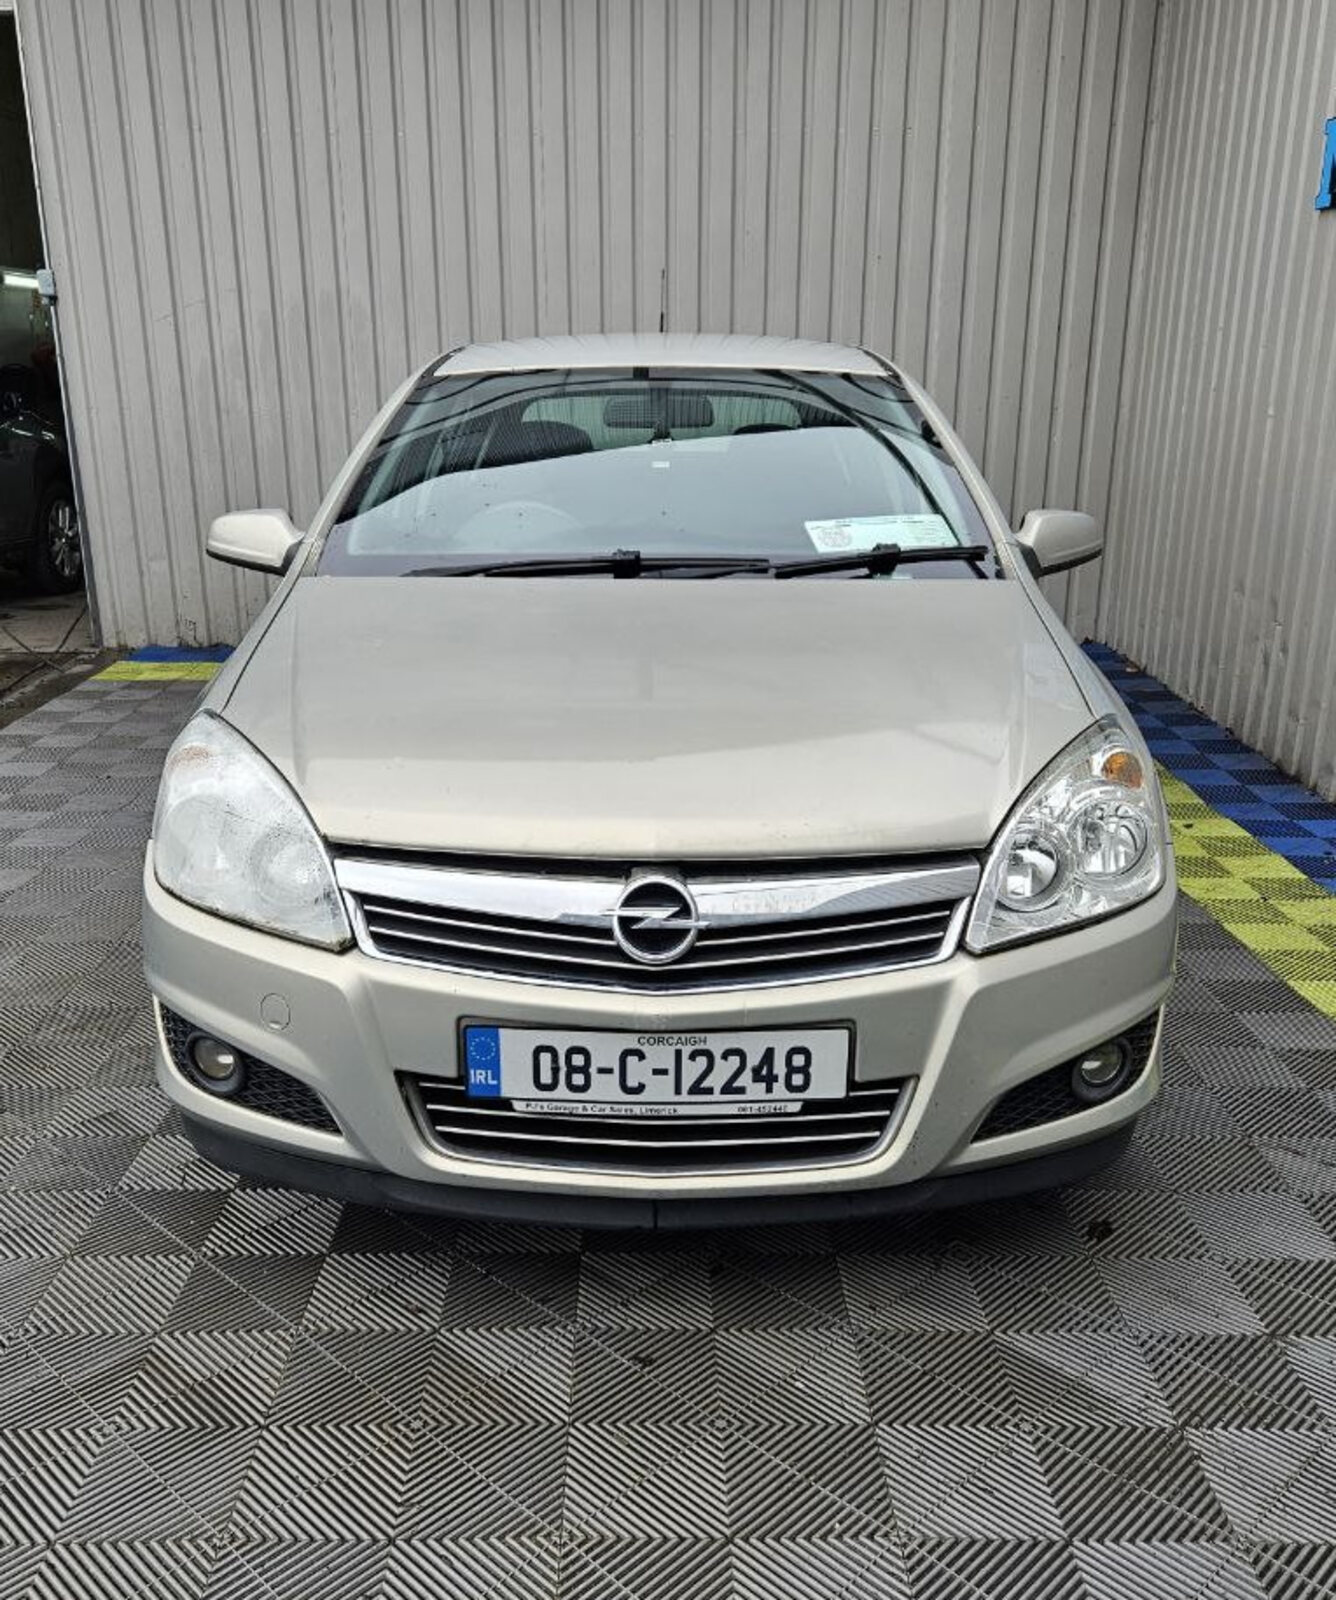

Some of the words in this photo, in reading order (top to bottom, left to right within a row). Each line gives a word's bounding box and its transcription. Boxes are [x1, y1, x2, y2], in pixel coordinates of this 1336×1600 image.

[637, 1035, 708, 1047] CORCAIGH
[532, 1044, 813, 1095] 08-C-12248
[470, 1069, 498, 1085] IRL
[590, 1105, 606, 1113] Car
